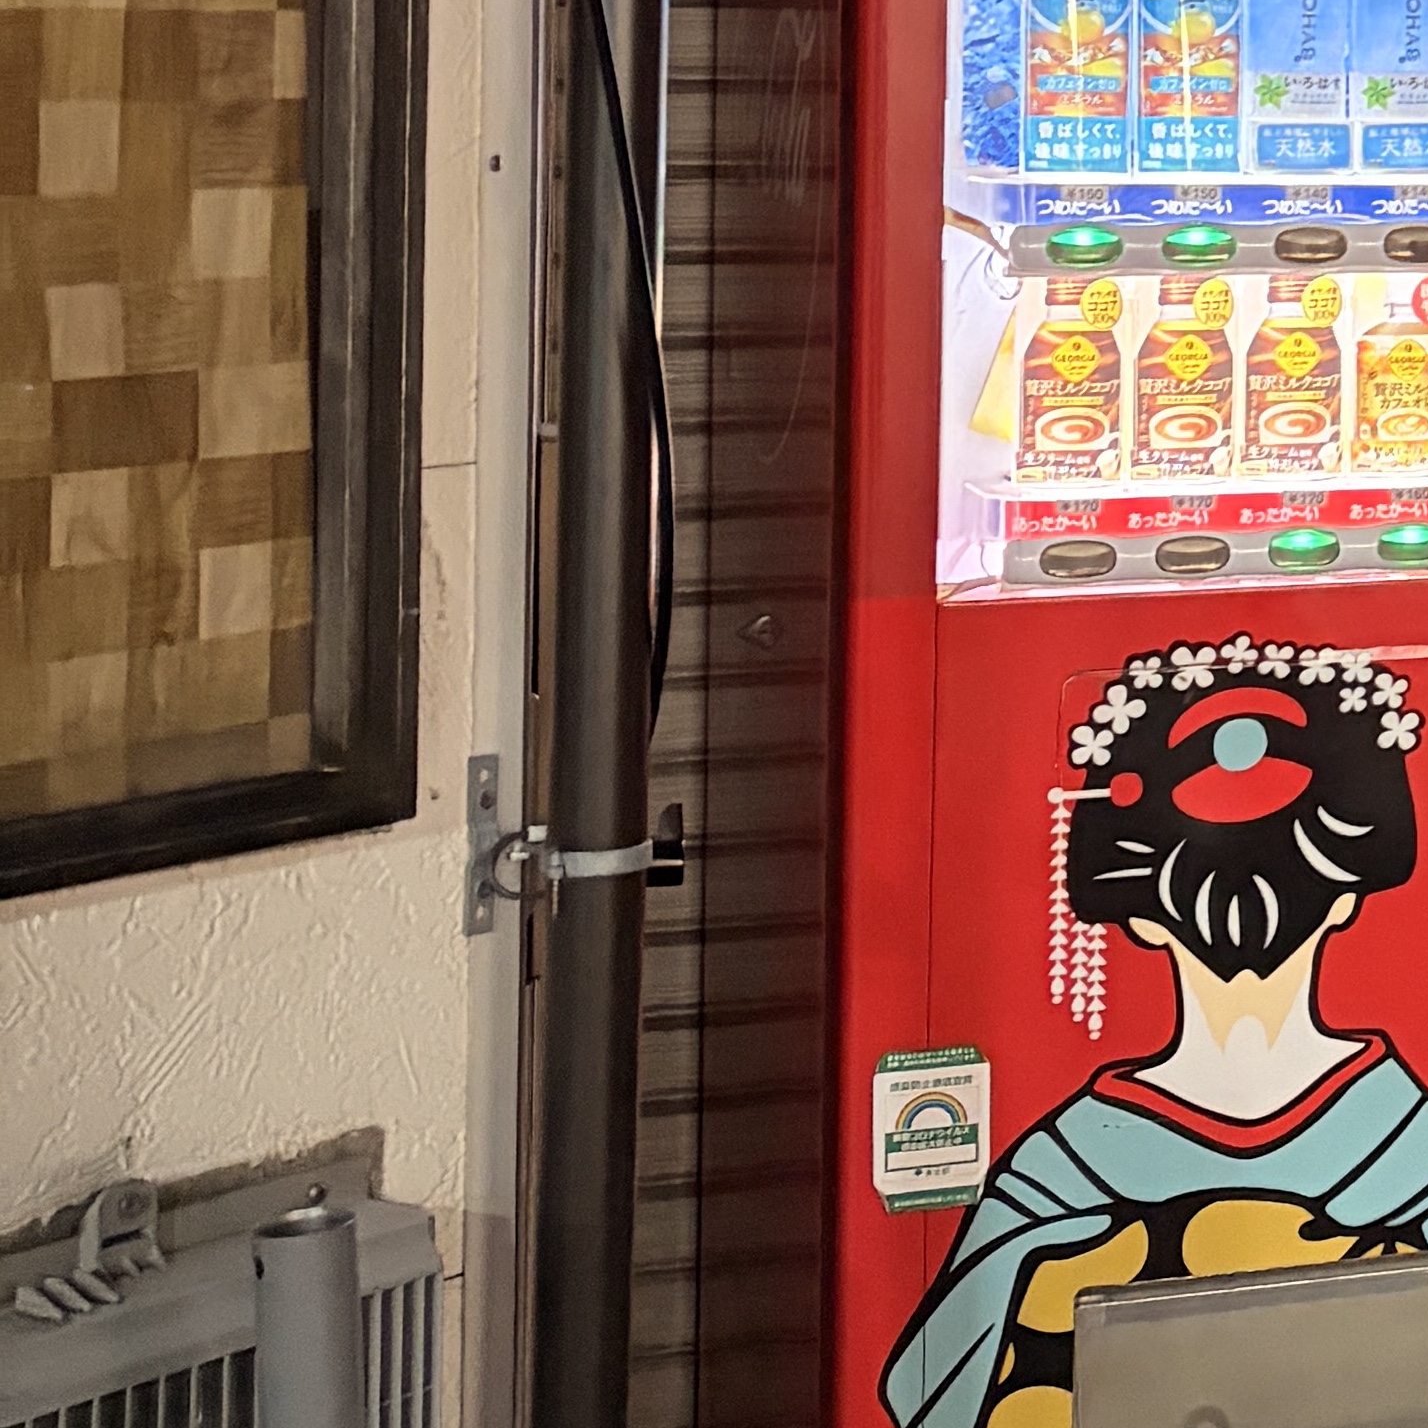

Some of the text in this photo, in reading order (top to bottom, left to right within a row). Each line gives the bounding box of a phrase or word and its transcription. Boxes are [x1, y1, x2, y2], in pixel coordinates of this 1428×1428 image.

[1274, 138, 1336, 159] 天然水
[1087, 300, 1118, 312] ココア
[1200, 299, 1231, 312] ココア
[1308, 298, 1338, 310] ココア
